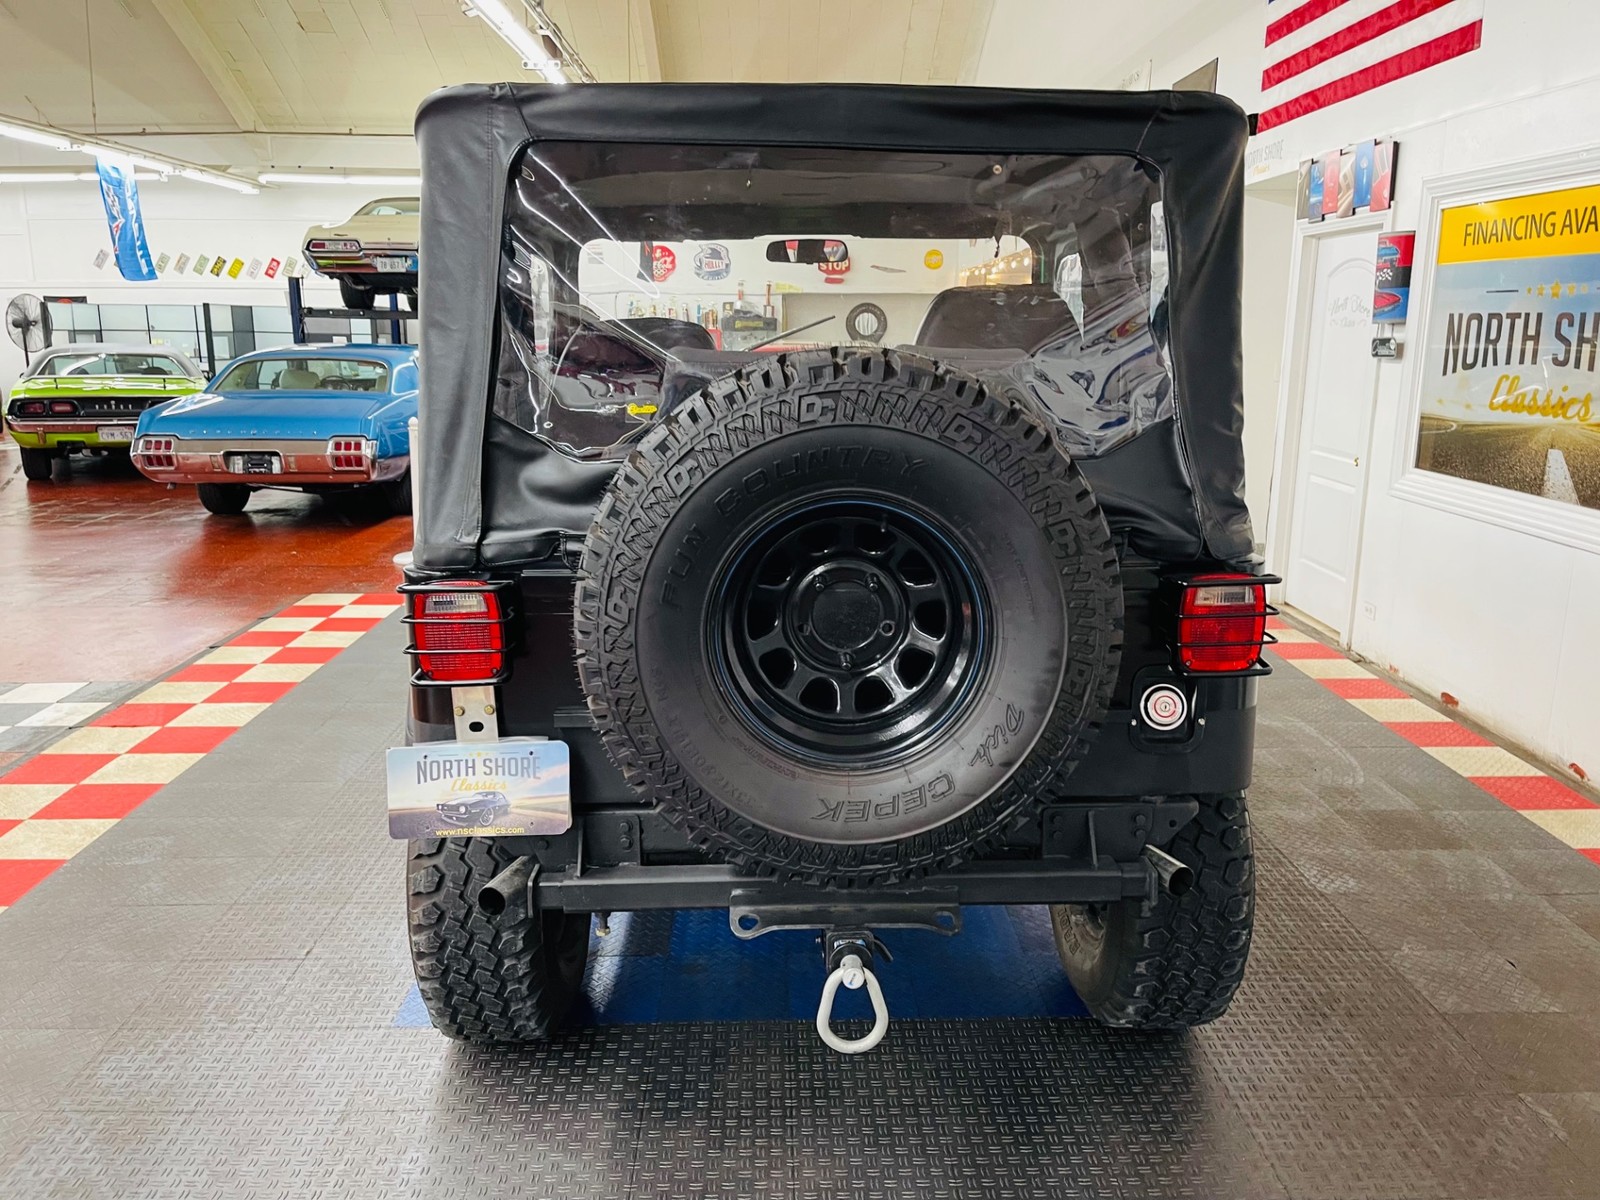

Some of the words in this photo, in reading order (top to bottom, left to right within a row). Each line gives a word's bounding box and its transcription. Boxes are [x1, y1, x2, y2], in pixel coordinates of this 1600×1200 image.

[1463, 210, 1556, 247] FINANCING
[819, 259, 850, 271] STOP
[1442, 312, 1543, 376] NORTH
[1488, 373, 1597, 423] Classics
[659, 522, 711, 608] FUN
[714, 445, 930, 517] COUNTRY
[416, 758, 476, 784] NORTH
[483, 757, 541, 779] SHORE
[451, 778, 508, 792] Classics
[810, 771, 957, 824] CEPEK
[436, 825, 525, 837] www.nsclassics.com
